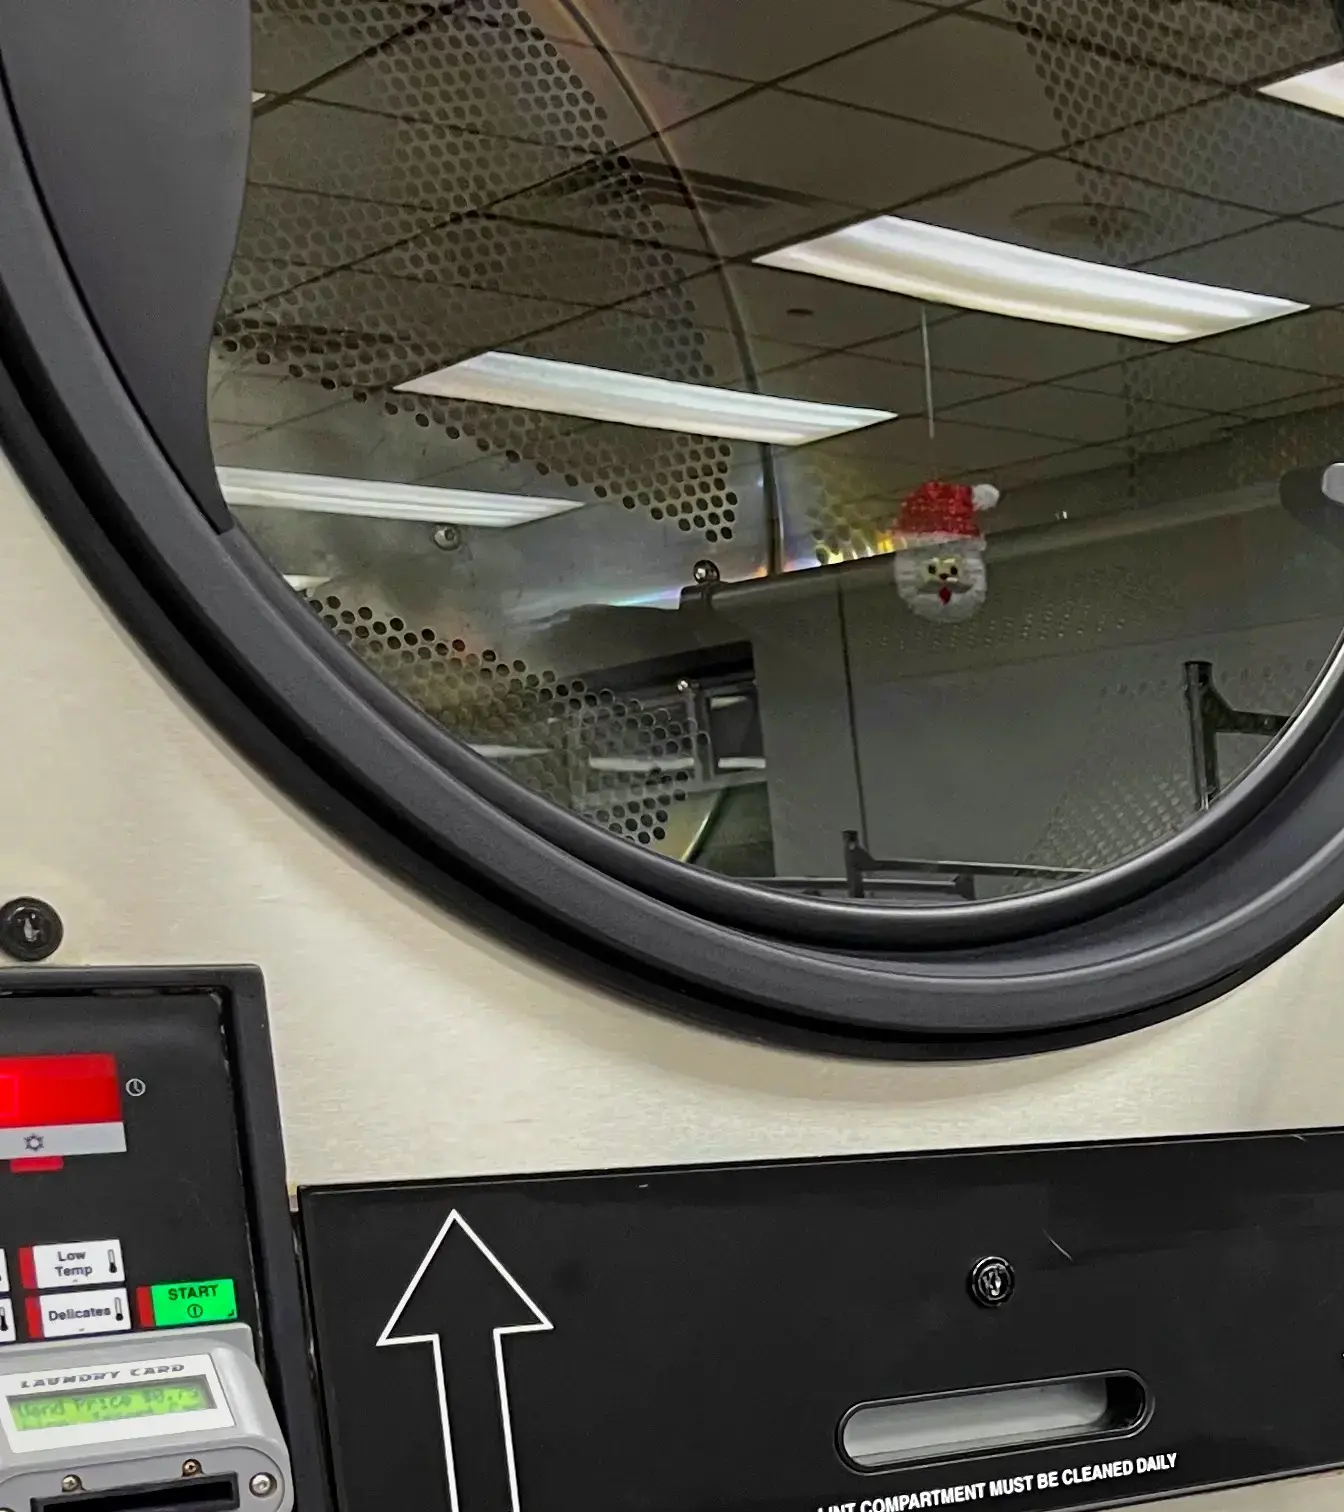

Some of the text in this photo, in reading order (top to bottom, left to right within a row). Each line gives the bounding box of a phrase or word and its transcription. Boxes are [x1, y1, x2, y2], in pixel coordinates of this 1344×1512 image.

[57, 1251, 86, 1262] Low
[55, 1265, 93, 1277] Temp
[168, 1284, 219, 1301] START
[48, 1307, 111, 1322] Delicates
[21, 1364, 185, 1389] LAUNDRY CARD
[990, 1475, 1034, 1496] MUST
[1037, 1472, 1059, 1490] BE
[1061, 1459, 1133, 1485] CLEANED
[1136, 1453, 1177, 1472] DAILY
